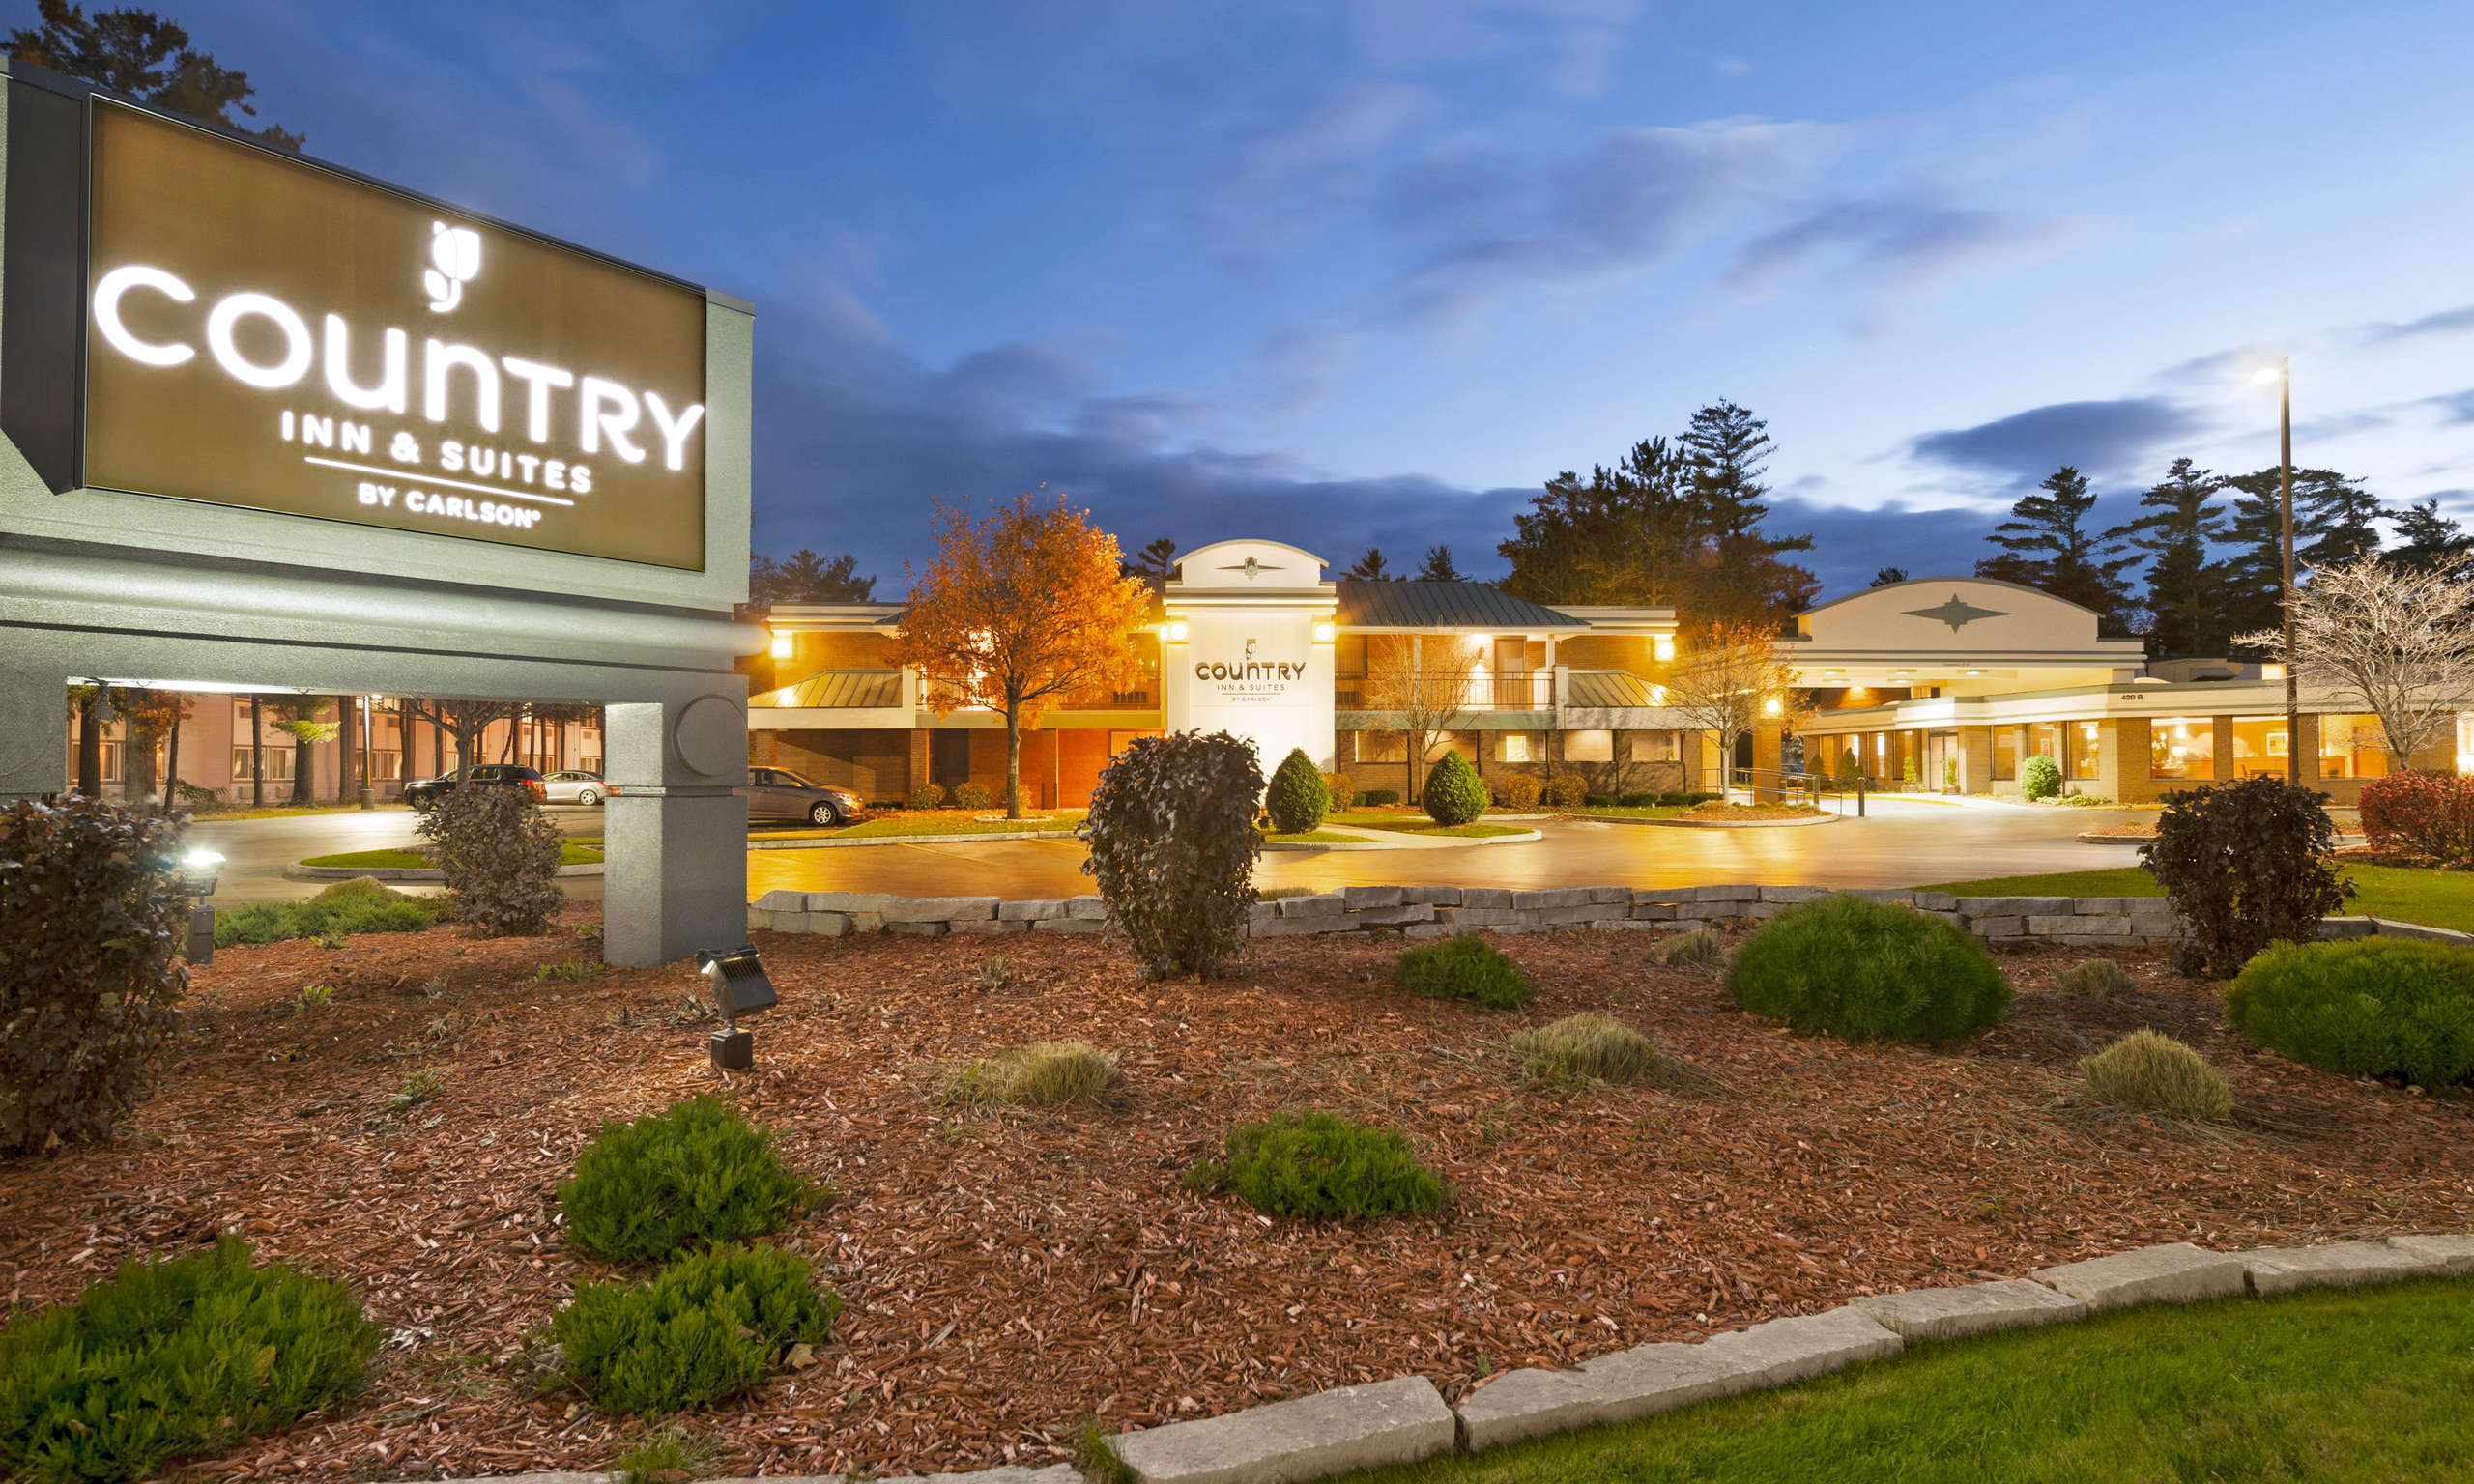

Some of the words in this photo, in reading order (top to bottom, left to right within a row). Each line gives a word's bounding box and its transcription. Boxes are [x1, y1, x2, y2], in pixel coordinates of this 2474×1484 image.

[281, 410, 371, 455] INN
[390, 432, 421, 464] &
[441, 440, 592, 494] SUITES
[358, 482, 396, 507] BY
